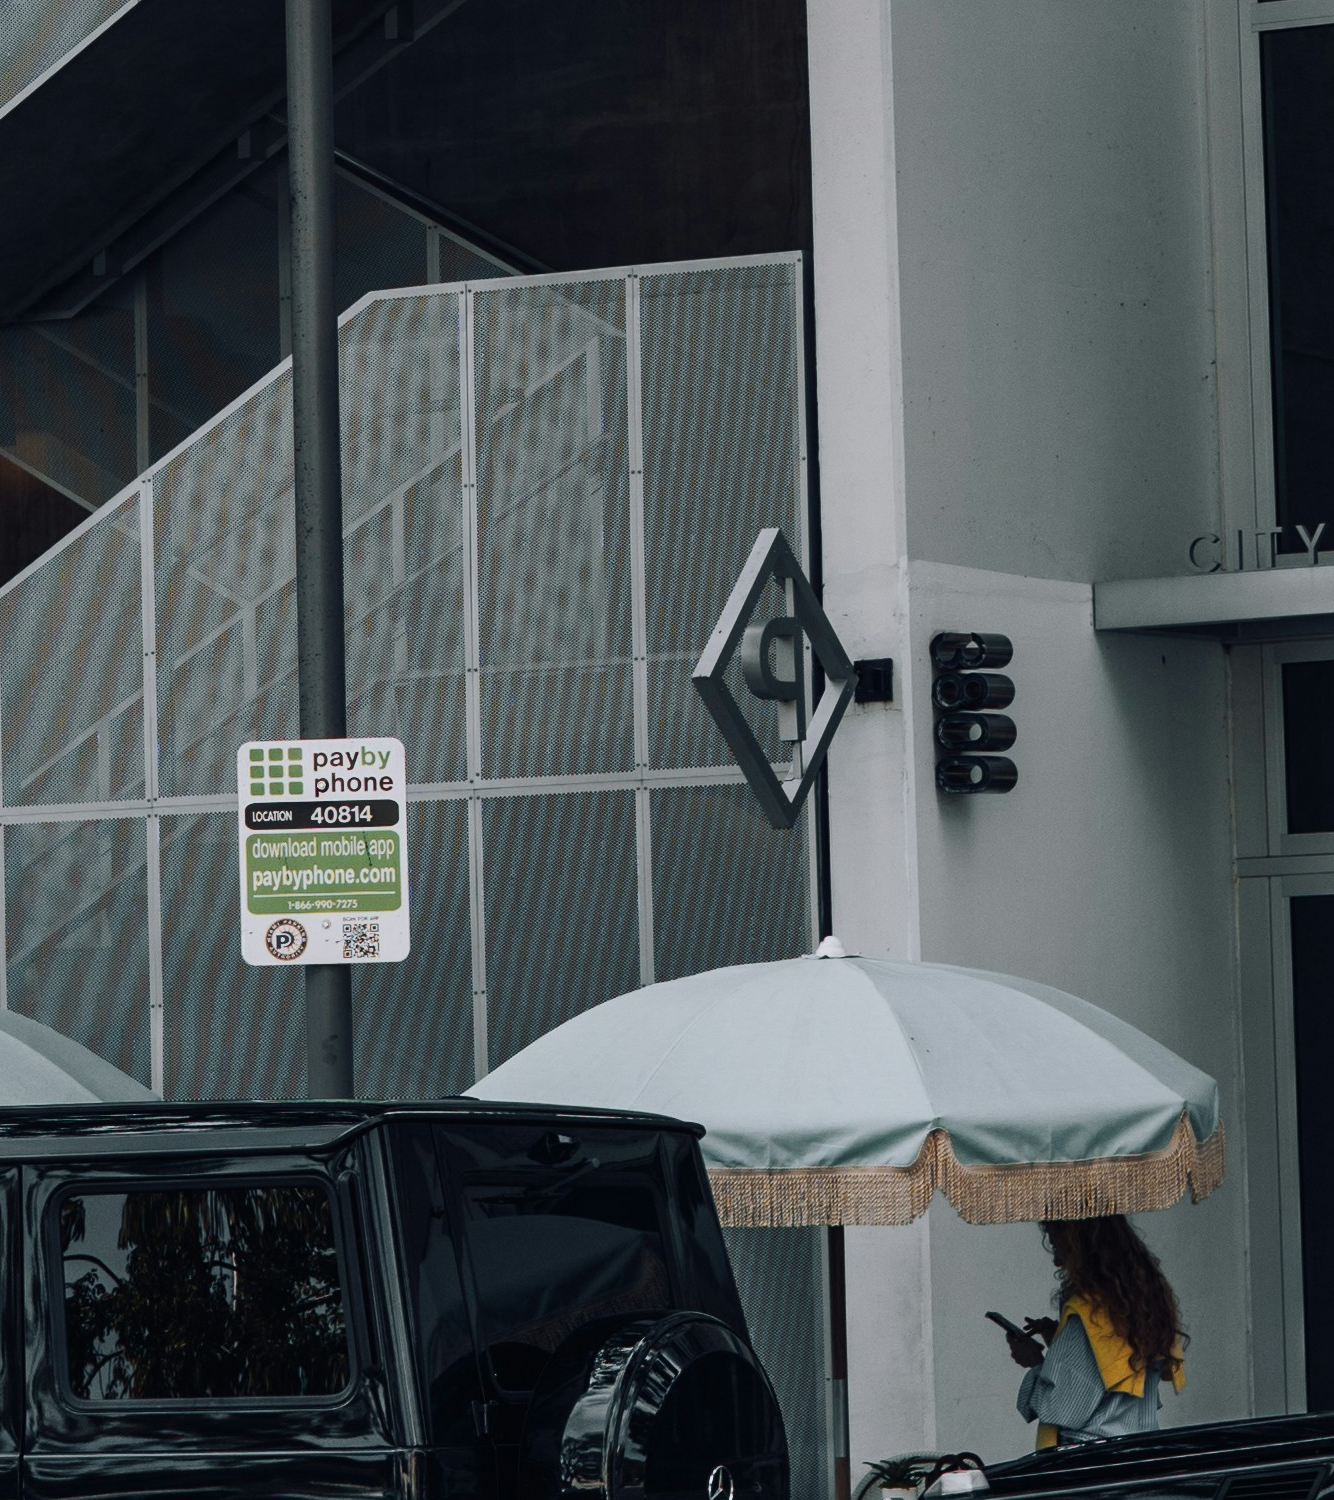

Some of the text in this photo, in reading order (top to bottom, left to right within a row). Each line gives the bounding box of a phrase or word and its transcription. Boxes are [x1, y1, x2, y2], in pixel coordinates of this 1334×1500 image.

[1189, 523, 1326, 573] CITY
[313, 746, 391, 771] payby
[314, 773, 394, 797] phone
[252, 805, 373, 824] LOCATION 40814
[252, 835, 395, 860] download mobile app
[252, 865, 396, 892] paybyphone.com
[287, 899, 358, 910] 1-866-990-7275
